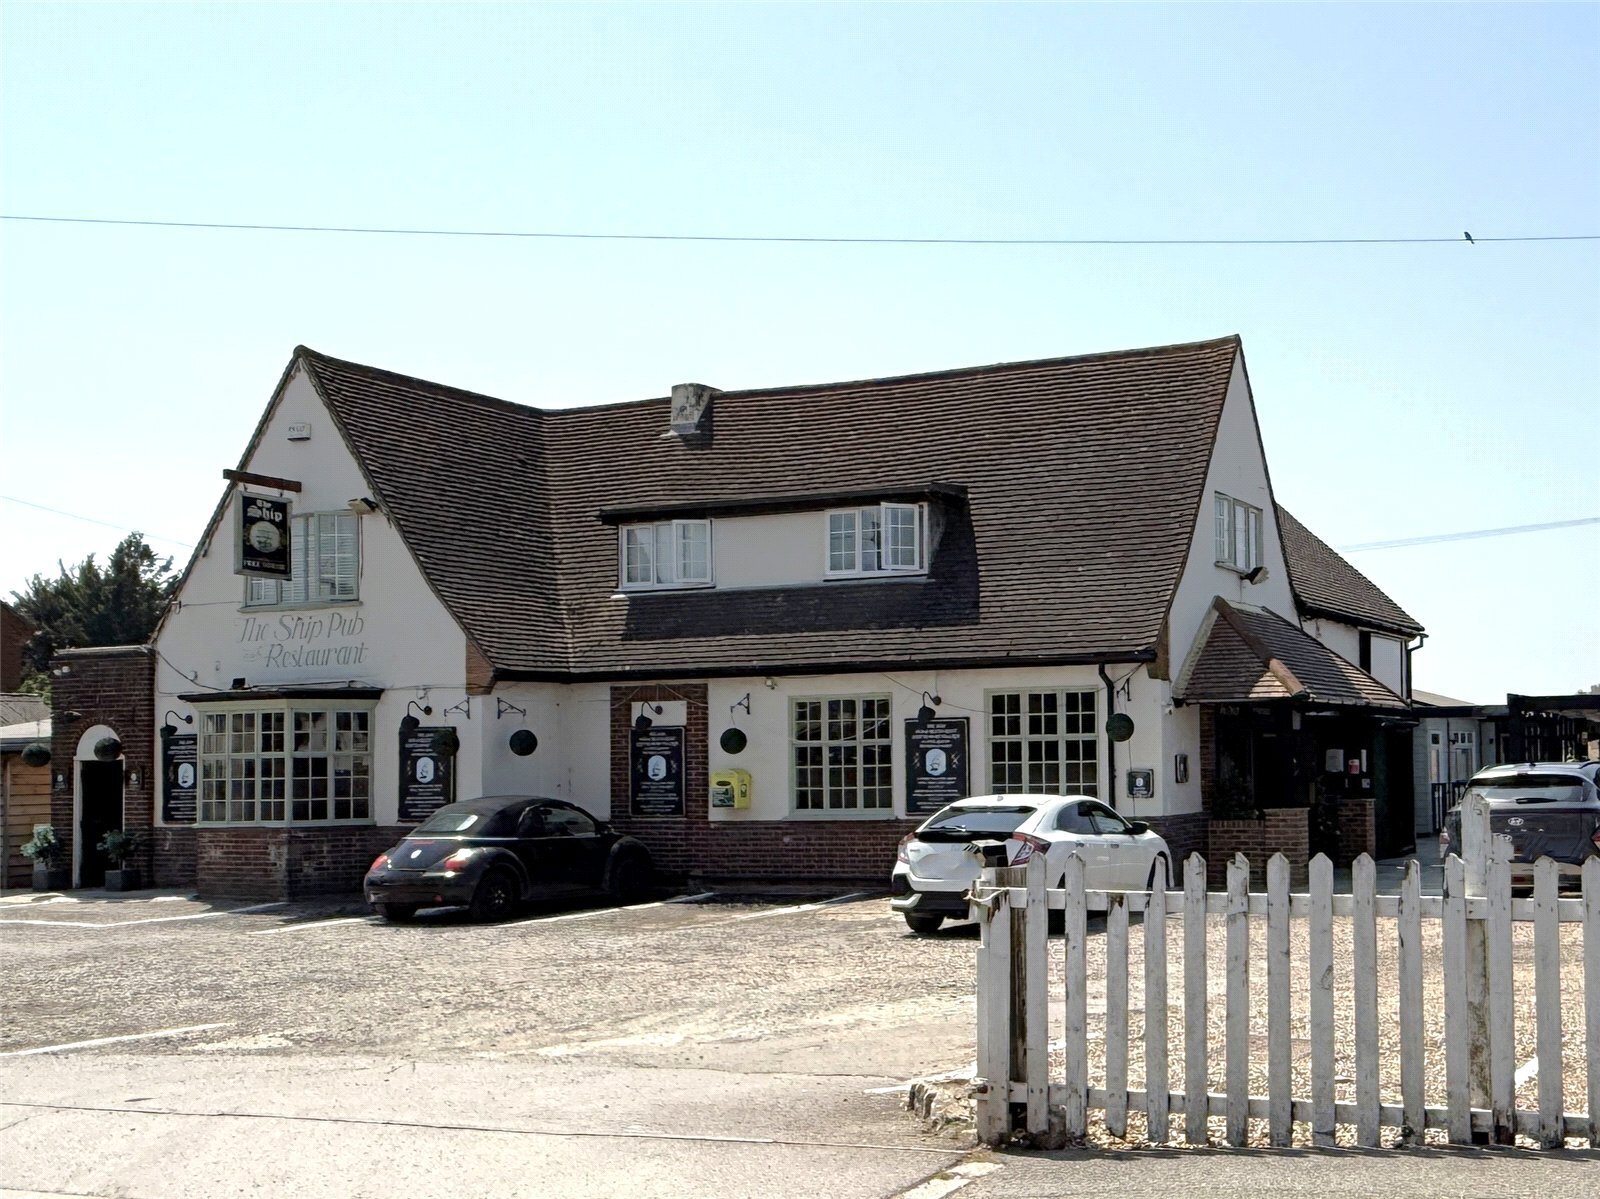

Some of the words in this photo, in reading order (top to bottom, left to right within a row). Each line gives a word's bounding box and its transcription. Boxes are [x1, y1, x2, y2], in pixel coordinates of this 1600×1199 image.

[247, 505, 282, 522] Ship
[240, 617, 269, 641] The
[274, 615, 323, 643] Ship
[328, 612, 364, 638] Pub
[265, 642, 368, 667] Restaurant
